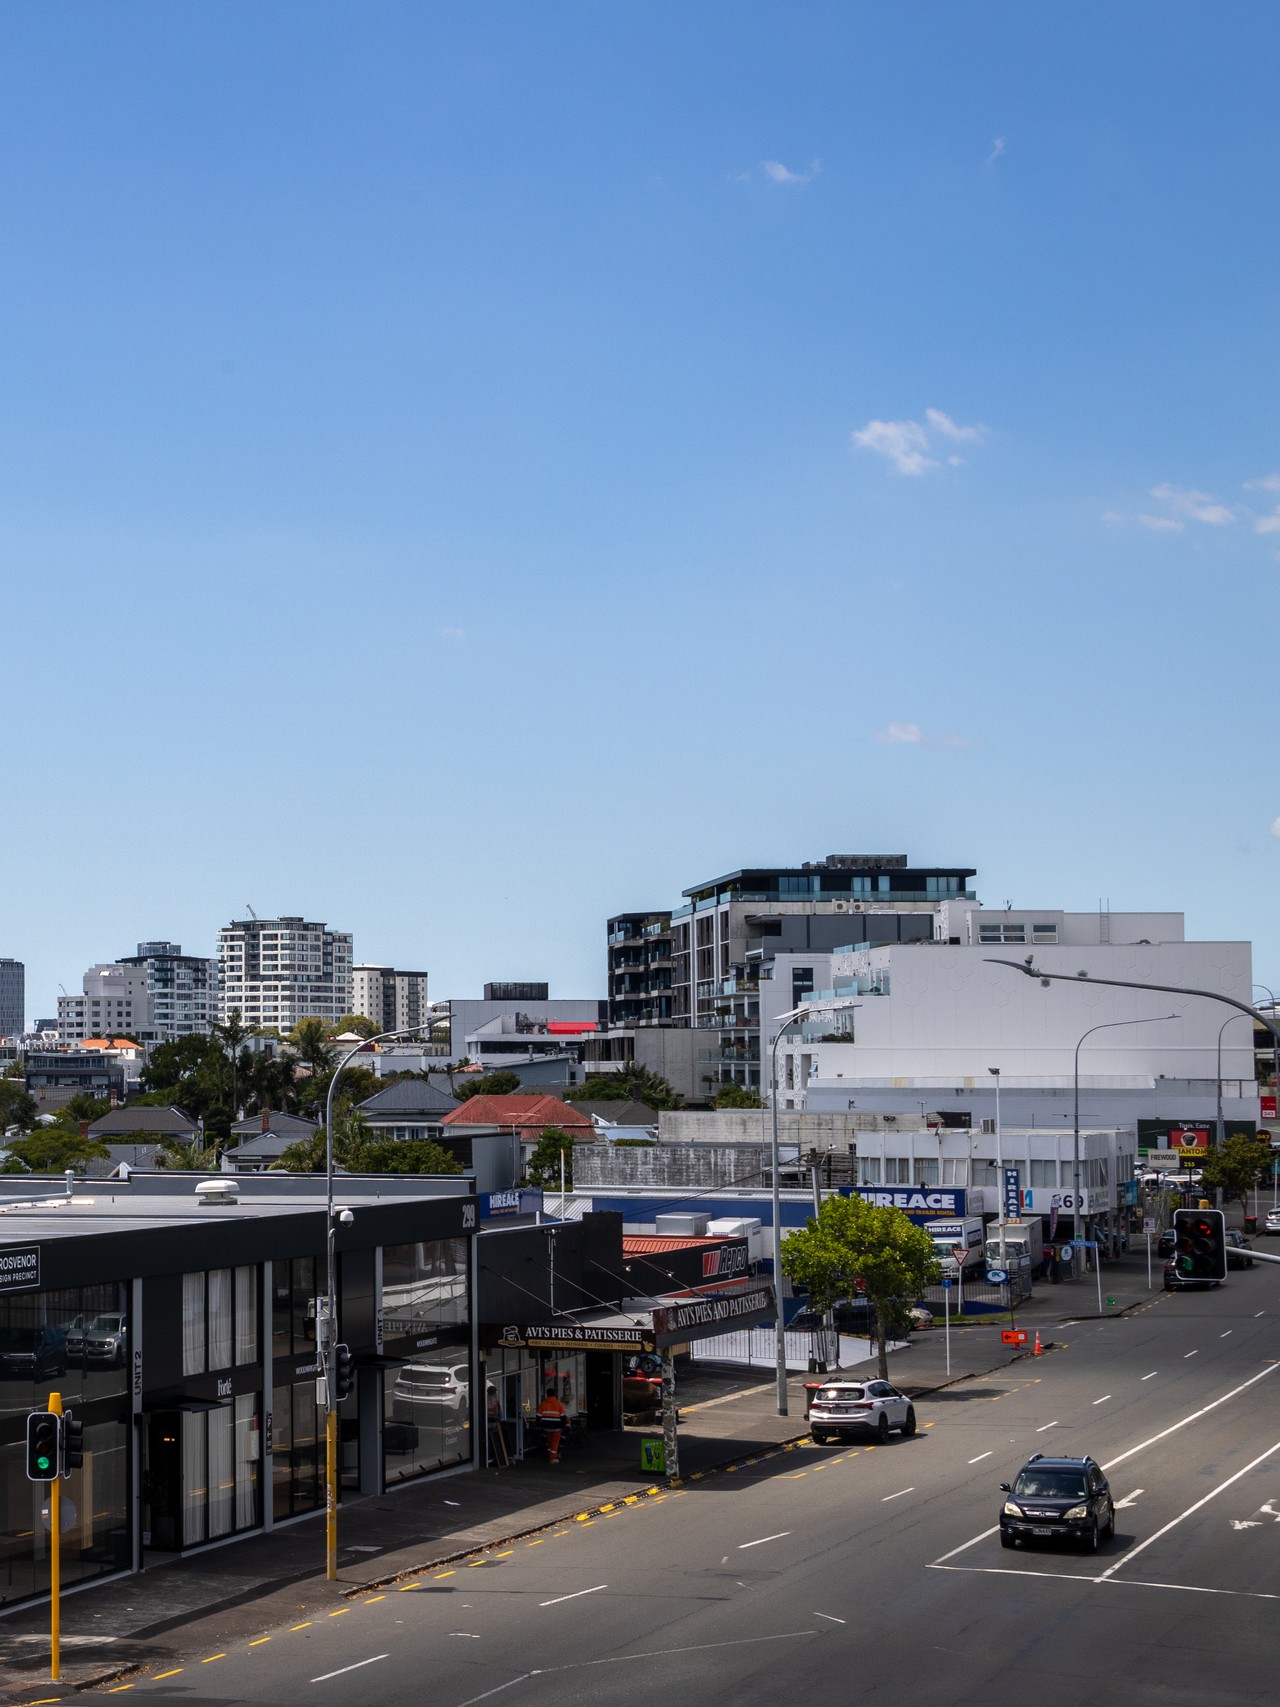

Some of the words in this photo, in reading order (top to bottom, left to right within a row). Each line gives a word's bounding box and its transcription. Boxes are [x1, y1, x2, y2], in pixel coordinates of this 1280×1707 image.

[1007, 1171, 1018, 1218] HIREACE
[462, 1204, 475, 1228] 299
[720, 1246, 747, 1278] Repco
[12, 1270, 37, 1282] PRECINCT
[695, 1302, 712, 1323] PIES
[713, 1300, 729, 1320] AND
[729, 1291, 767, 1317] PATISSERIE
[525, 1326, 550, 1338] AVI'S
[551, 1328, 573, 1339] PIES
[574, 1329, 584, 1339] &
[585, 1329, 643, 1342] PATISSERIE
[134, 1350, 142, 1359] 2
[134, 1361, 142, 1396] UNIT
[217, 1377, 232, 1396] Forté
